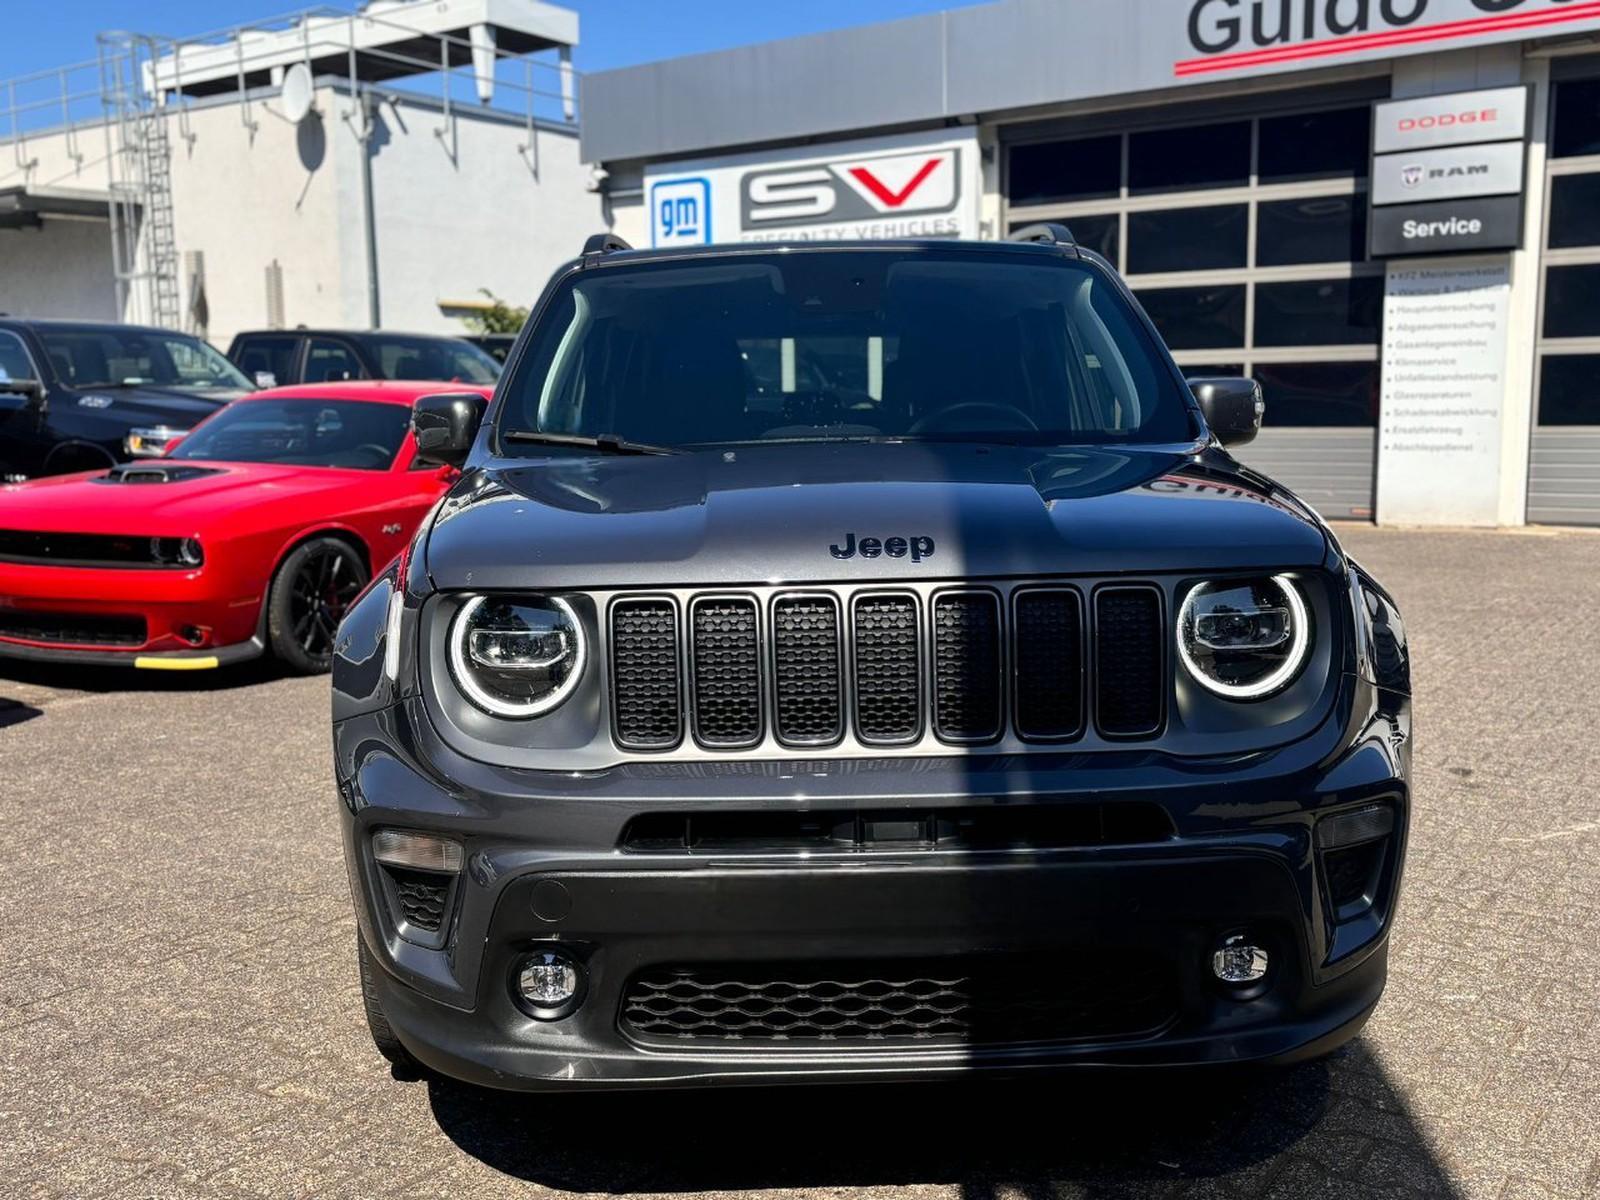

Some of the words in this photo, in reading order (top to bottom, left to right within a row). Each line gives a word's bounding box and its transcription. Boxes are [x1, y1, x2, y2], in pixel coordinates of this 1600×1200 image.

[1397, 108, 1498, 131] DODGE
[1428, 164, 1489, 179] RAM
[661, 197, 698, 237] gm
[1402, 216, 1482, 239] Service
[854, 217, 958, 241] VEHICLES
[829, 532, 936, 564] Jeep
